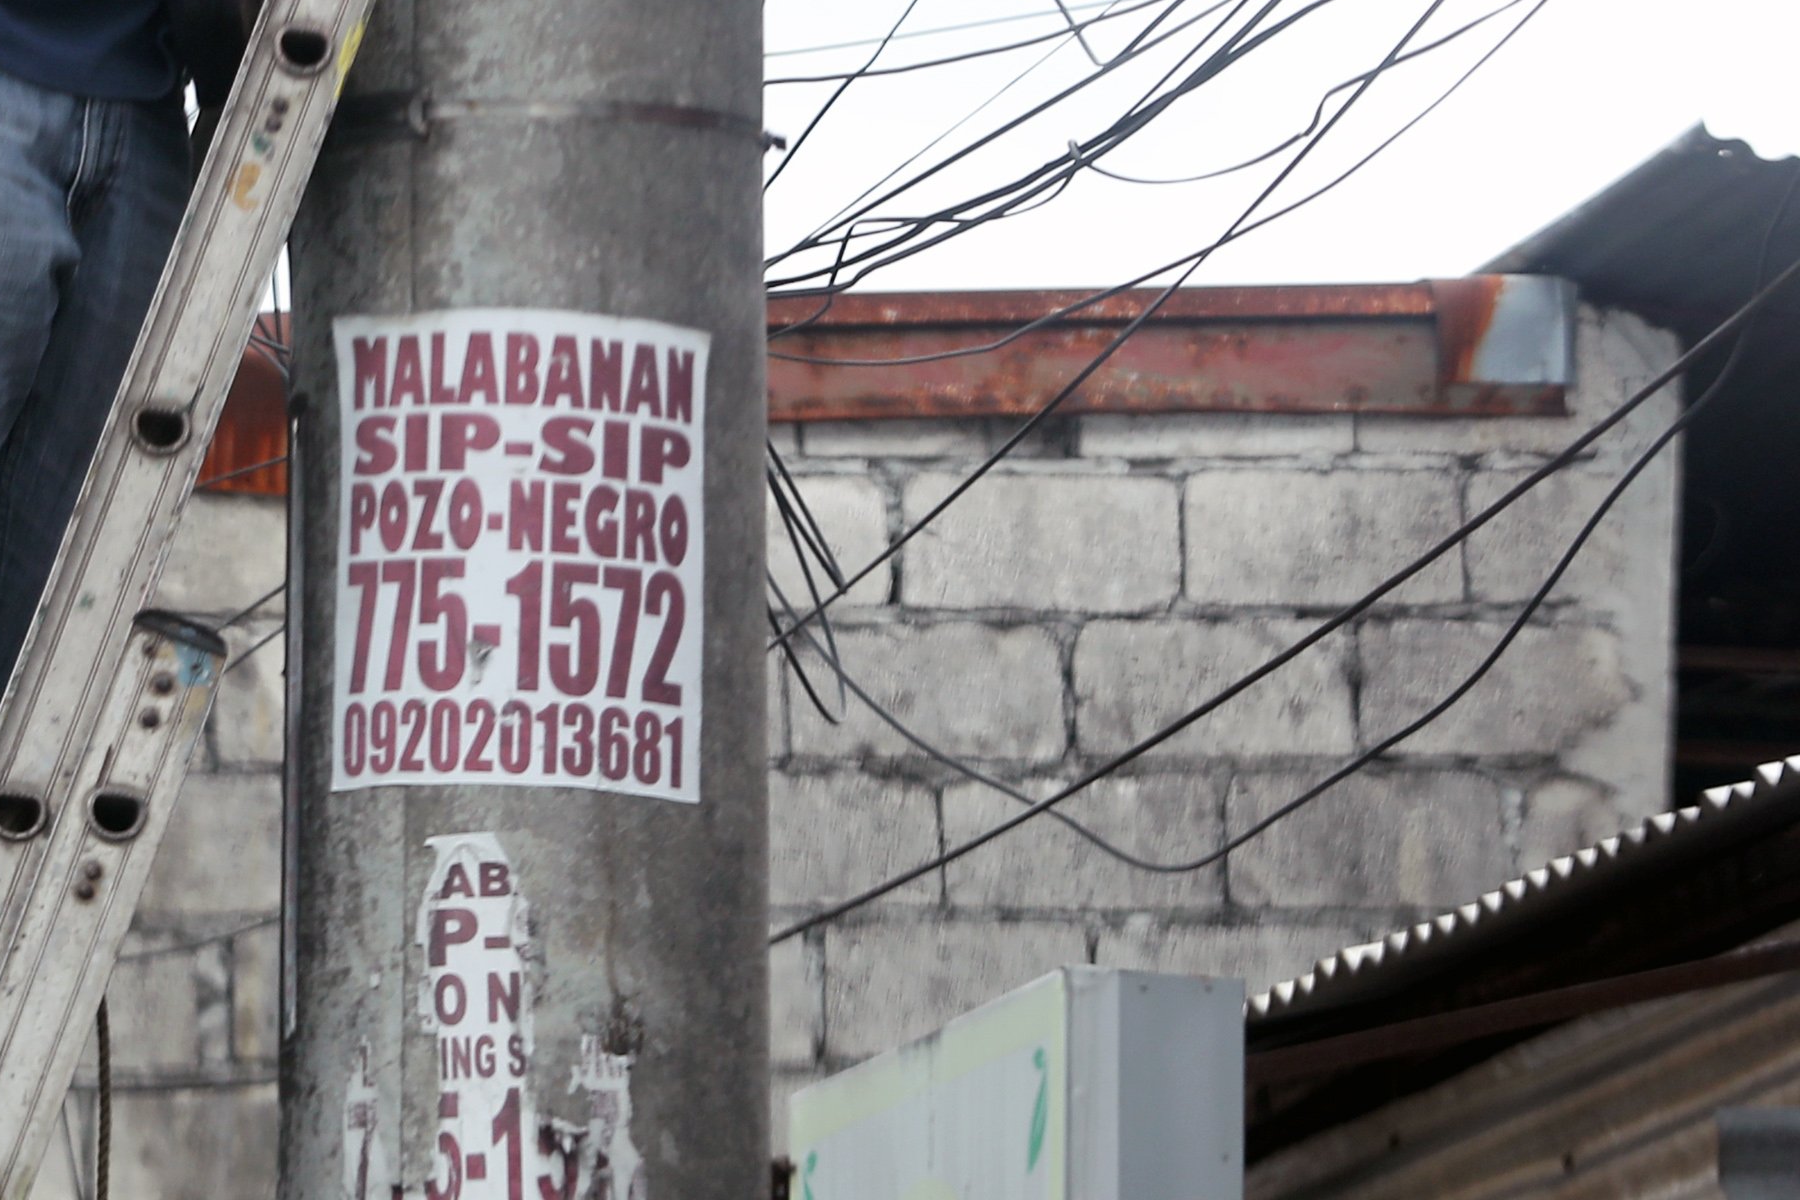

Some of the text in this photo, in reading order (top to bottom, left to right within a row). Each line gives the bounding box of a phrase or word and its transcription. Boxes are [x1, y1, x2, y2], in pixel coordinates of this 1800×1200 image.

[353, 332, 694, 423] MALABANAN
[354, 413, 691, 484] SIP-SIP
[350, 478, 689, 567] POZO-NEGRO
[348, 558, 685, 706] 775-1572
[344, 698, 682, 789] 09202013681
